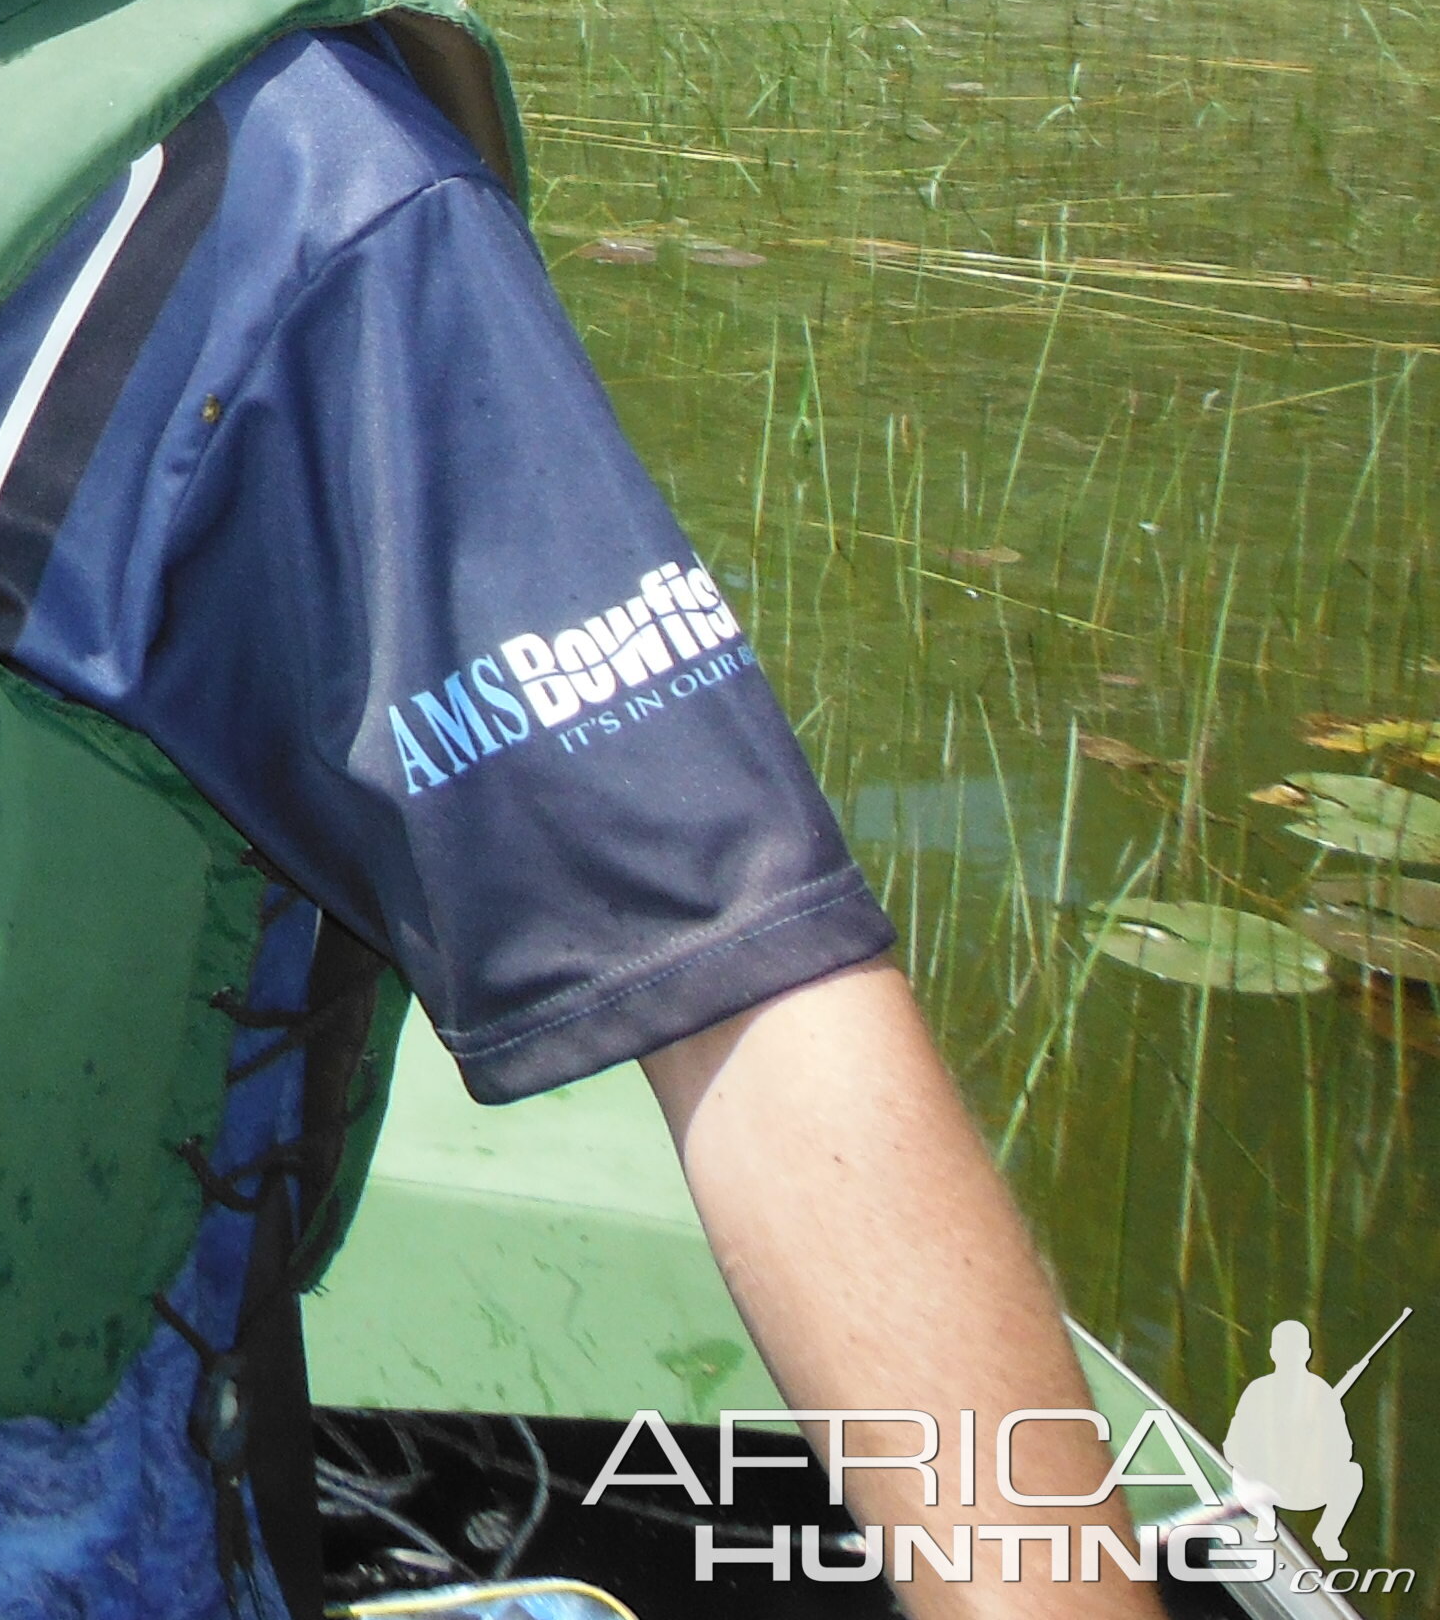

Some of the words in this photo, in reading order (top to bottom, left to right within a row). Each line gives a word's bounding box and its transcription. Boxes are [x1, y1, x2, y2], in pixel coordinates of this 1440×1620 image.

[387, 654, 530, 794] AMS
[559, 715, 621, 755] IT'S
[630, 689, 665, 726] IN
[670, 652, 742, 700] OUR
